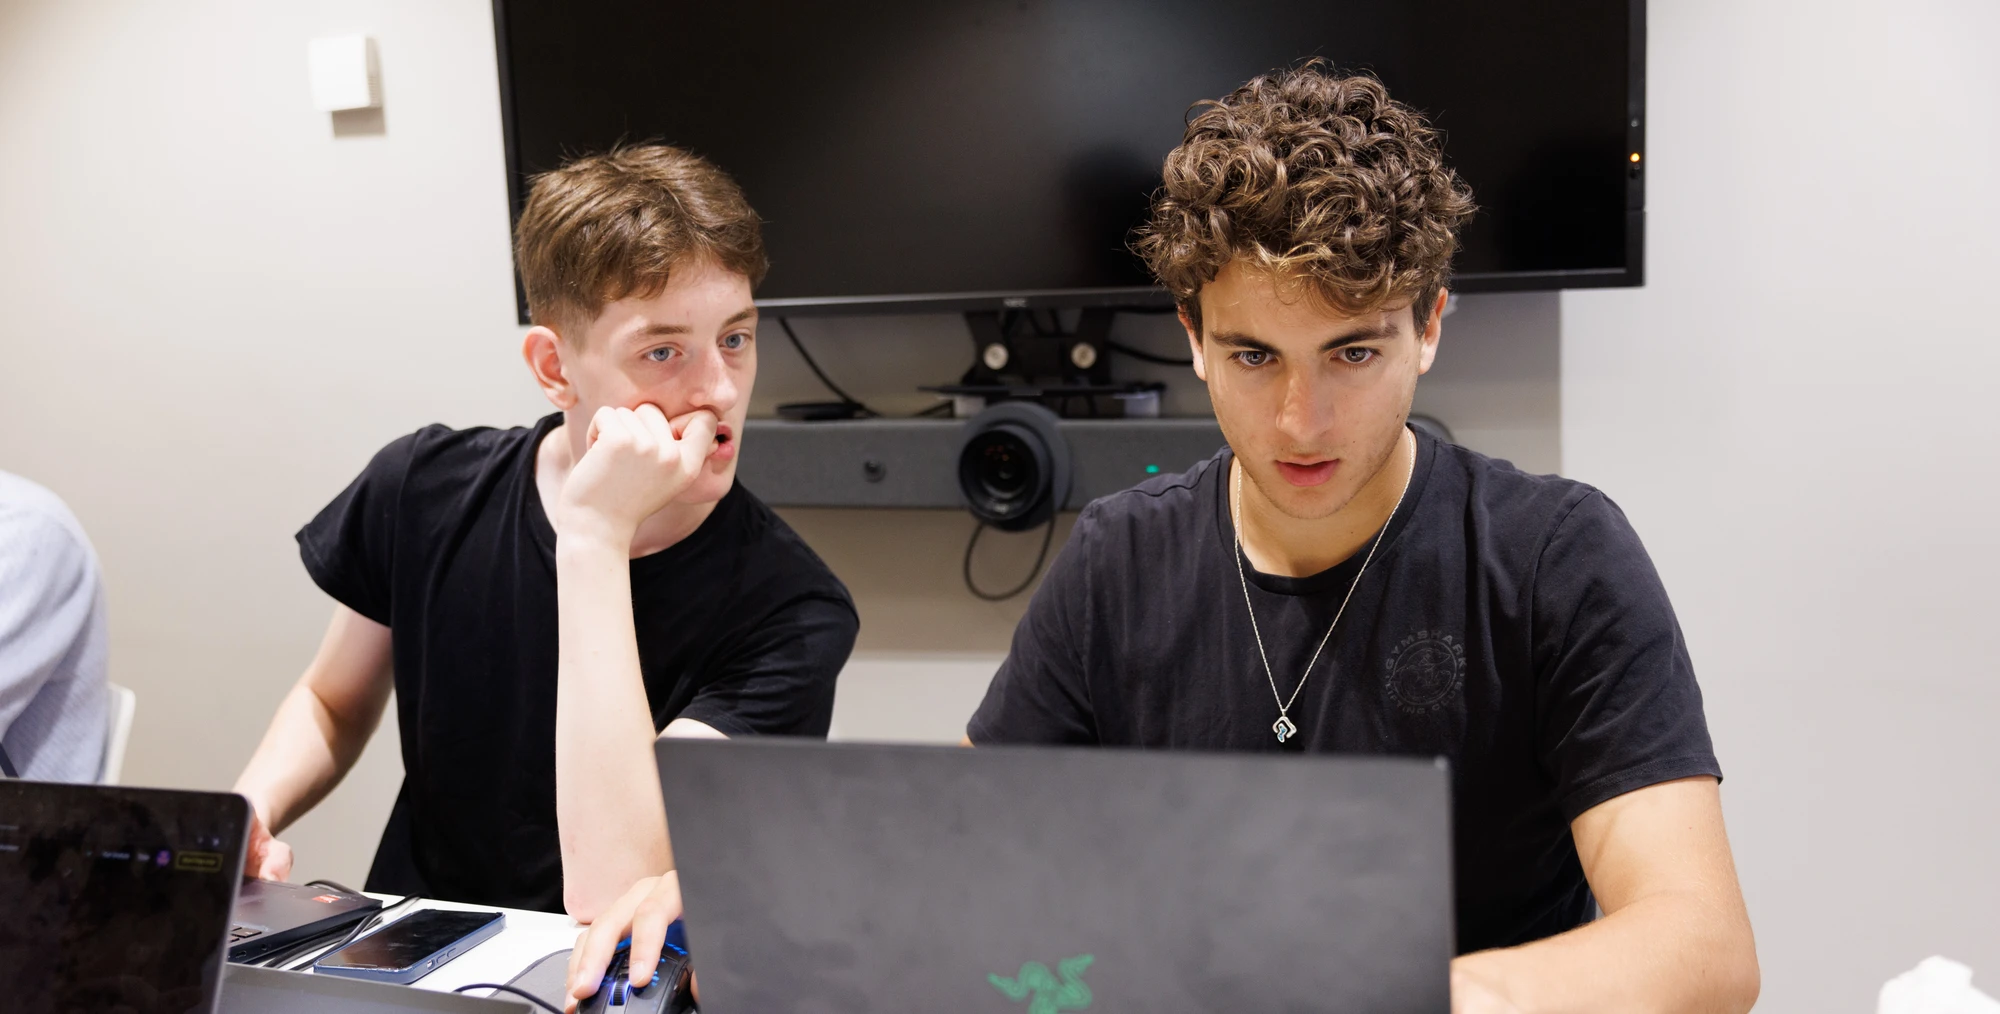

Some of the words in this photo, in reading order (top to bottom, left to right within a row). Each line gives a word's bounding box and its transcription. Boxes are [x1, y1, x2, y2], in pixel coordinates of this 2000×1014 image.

[1385, 630, 1467, 669] GYMSHARK
[1385, 683, 1426, 714] LIFTING
[1431, 682, 1463, 711] CLUB
